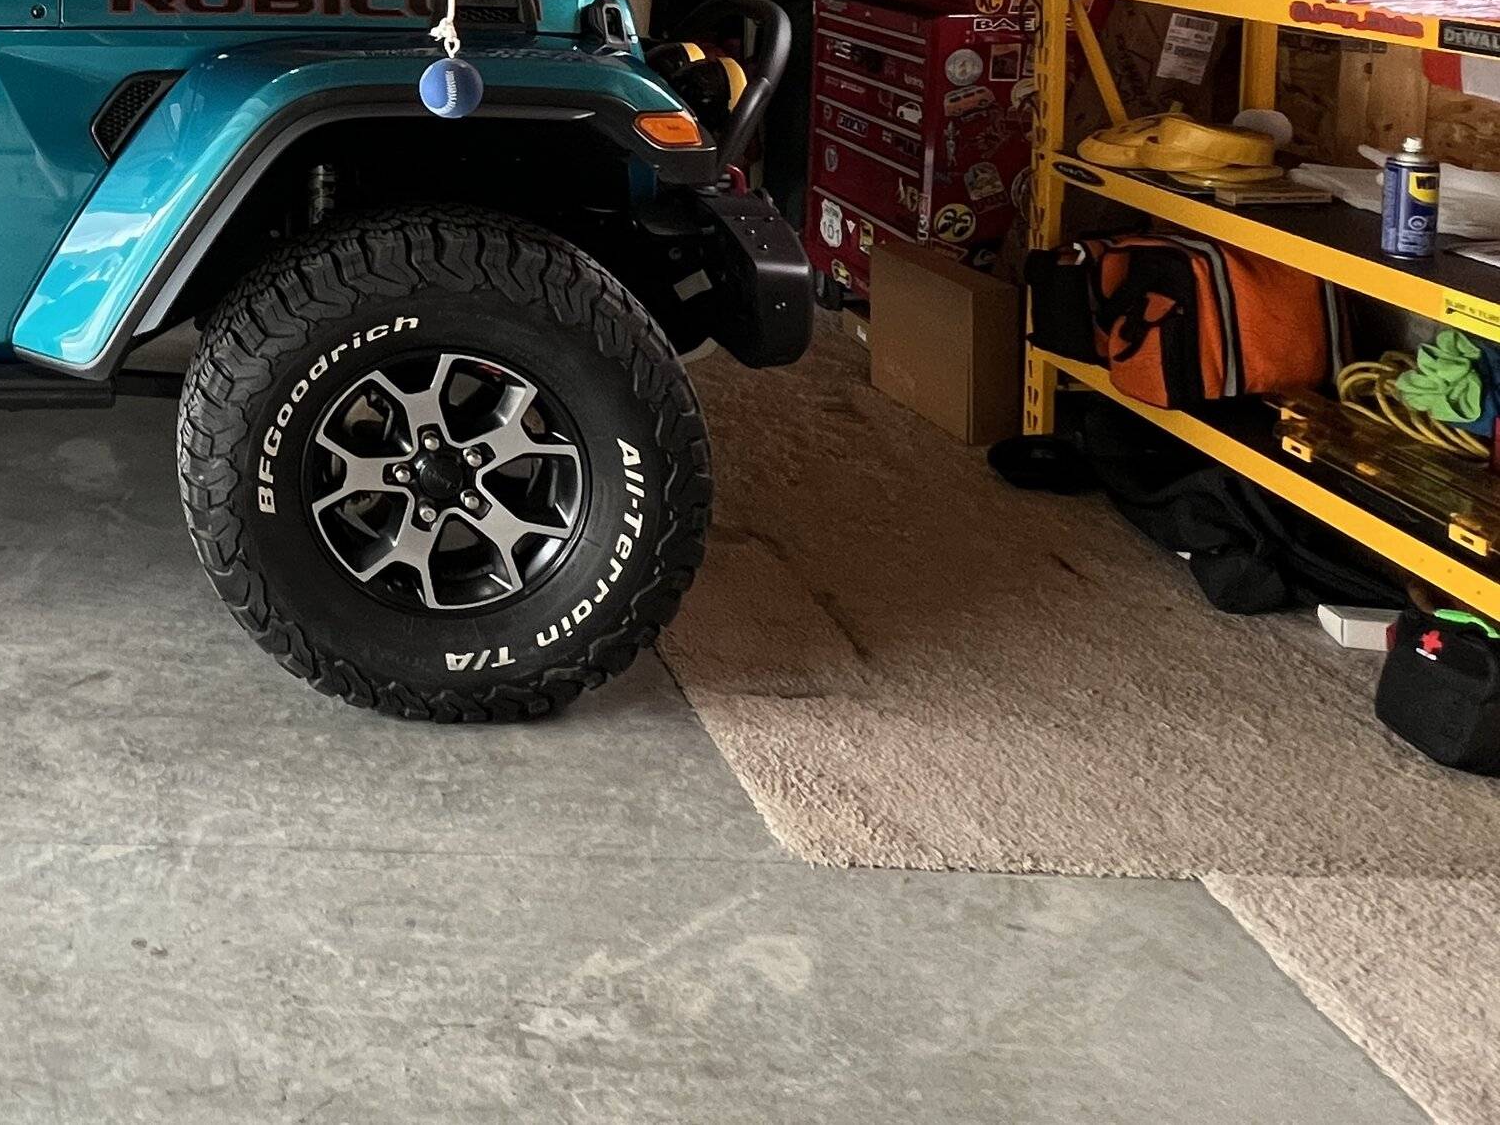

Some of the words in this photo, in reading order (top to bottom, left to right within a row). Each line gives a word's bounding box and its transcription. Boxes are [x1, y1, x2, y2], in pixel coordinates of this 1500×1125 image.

[1443, 27, 1500, 52] DEWAL
[258, 315, 420, 515] BFGoodrich
[536, 437, 646, 648] All-Terrain
[444, 646, 518, 672] T/A
